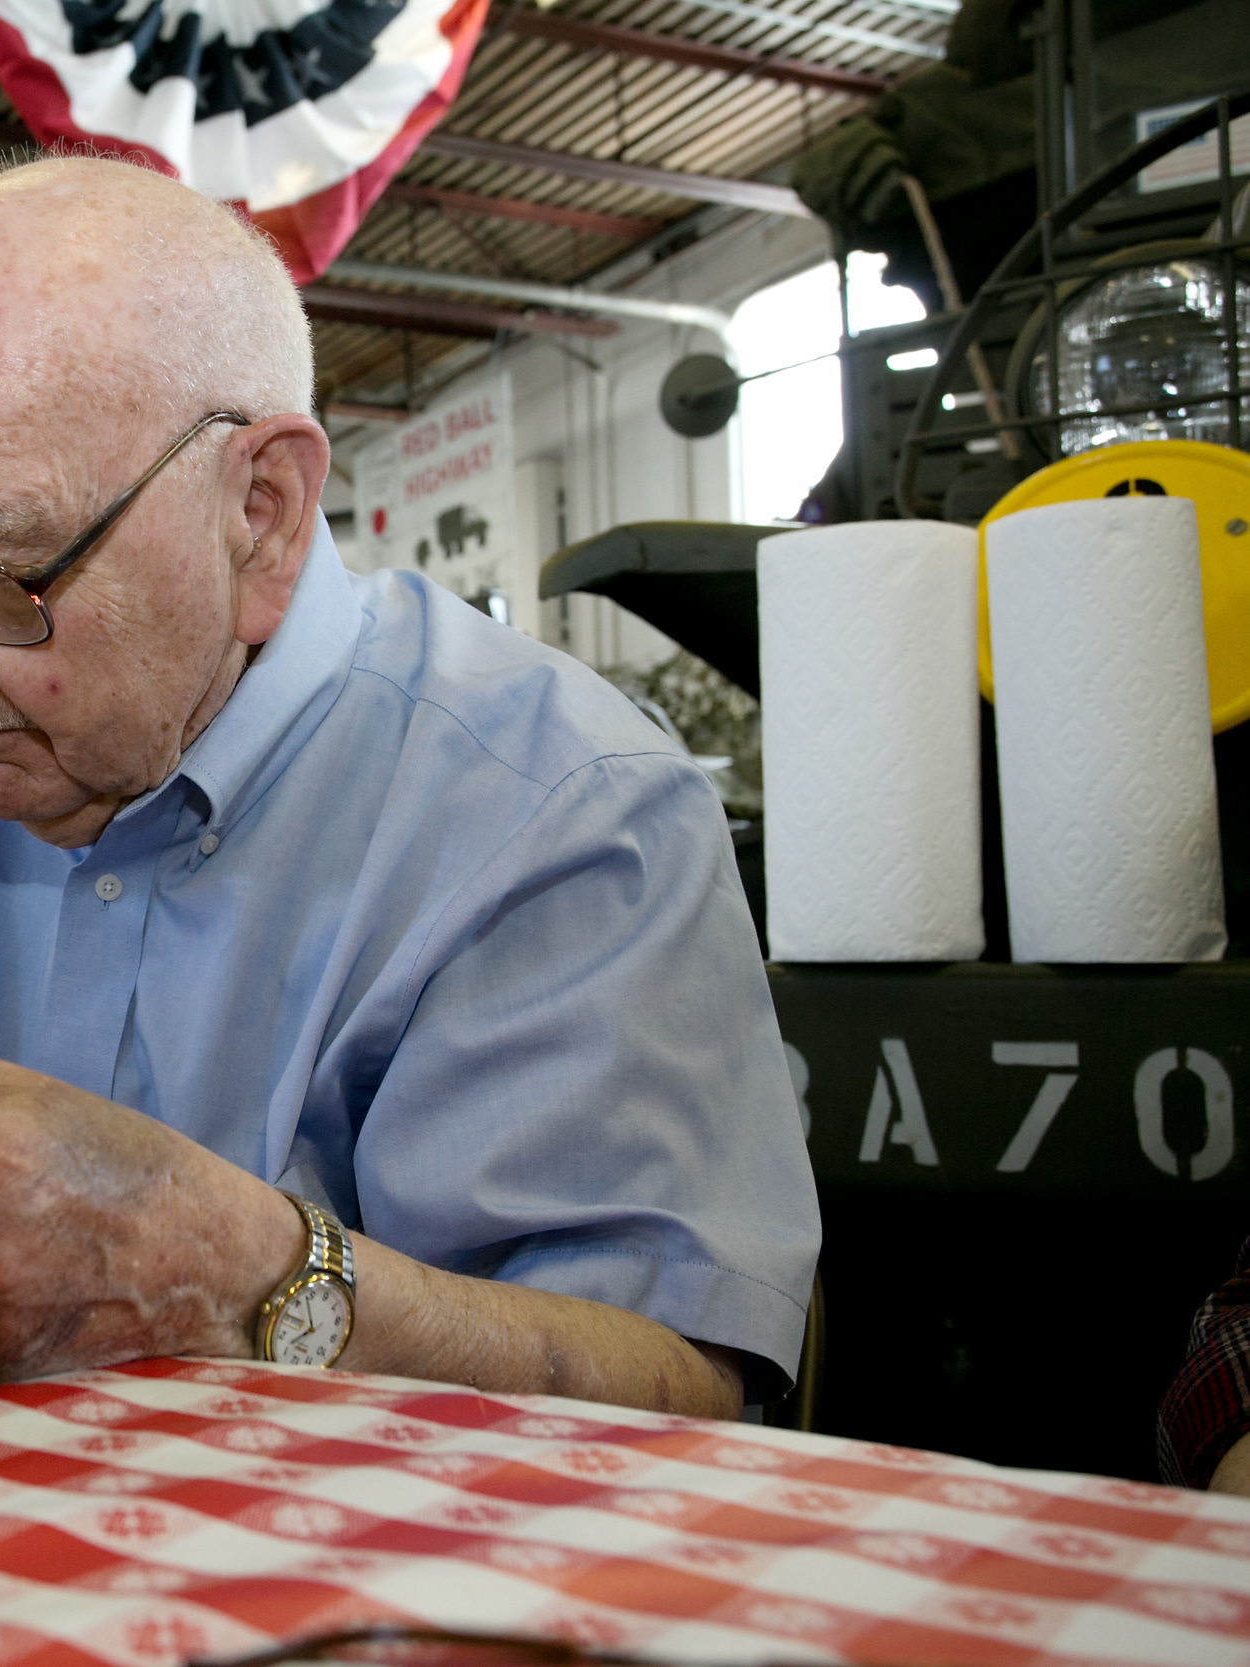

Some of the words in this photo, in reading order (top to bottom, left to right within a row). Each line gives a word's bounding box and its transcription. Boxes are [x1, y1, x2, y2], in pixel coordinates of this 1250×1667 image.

[401, 422, 441, 460] RED
[446, 397, 495, 442] BALL
[404, 439, 494, 502] HIGHWAY
